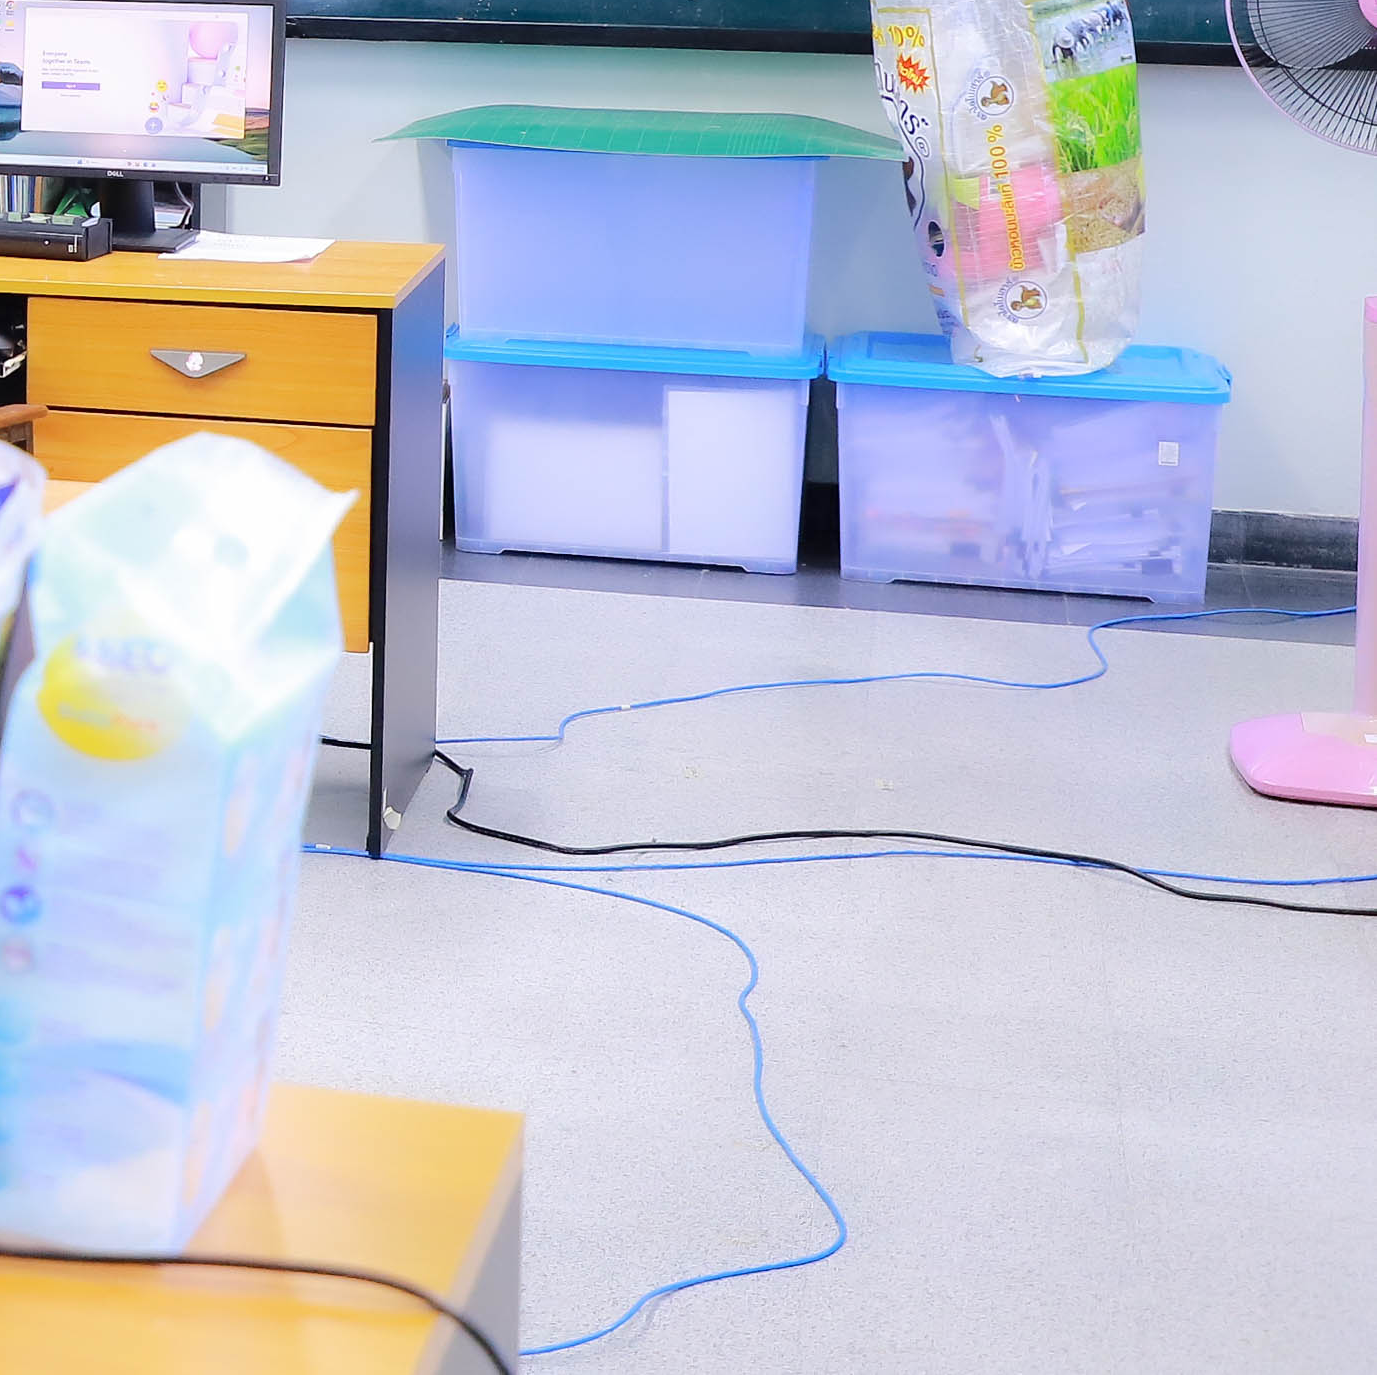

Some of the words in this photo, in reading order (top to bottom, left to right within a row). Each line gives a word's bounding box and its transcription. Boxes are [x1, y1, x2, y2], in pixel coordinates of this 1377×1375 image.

[106, 170, 124, 178] DELL
[998, 183, 1025, 271] ข้าวหอมมะลิแท้
